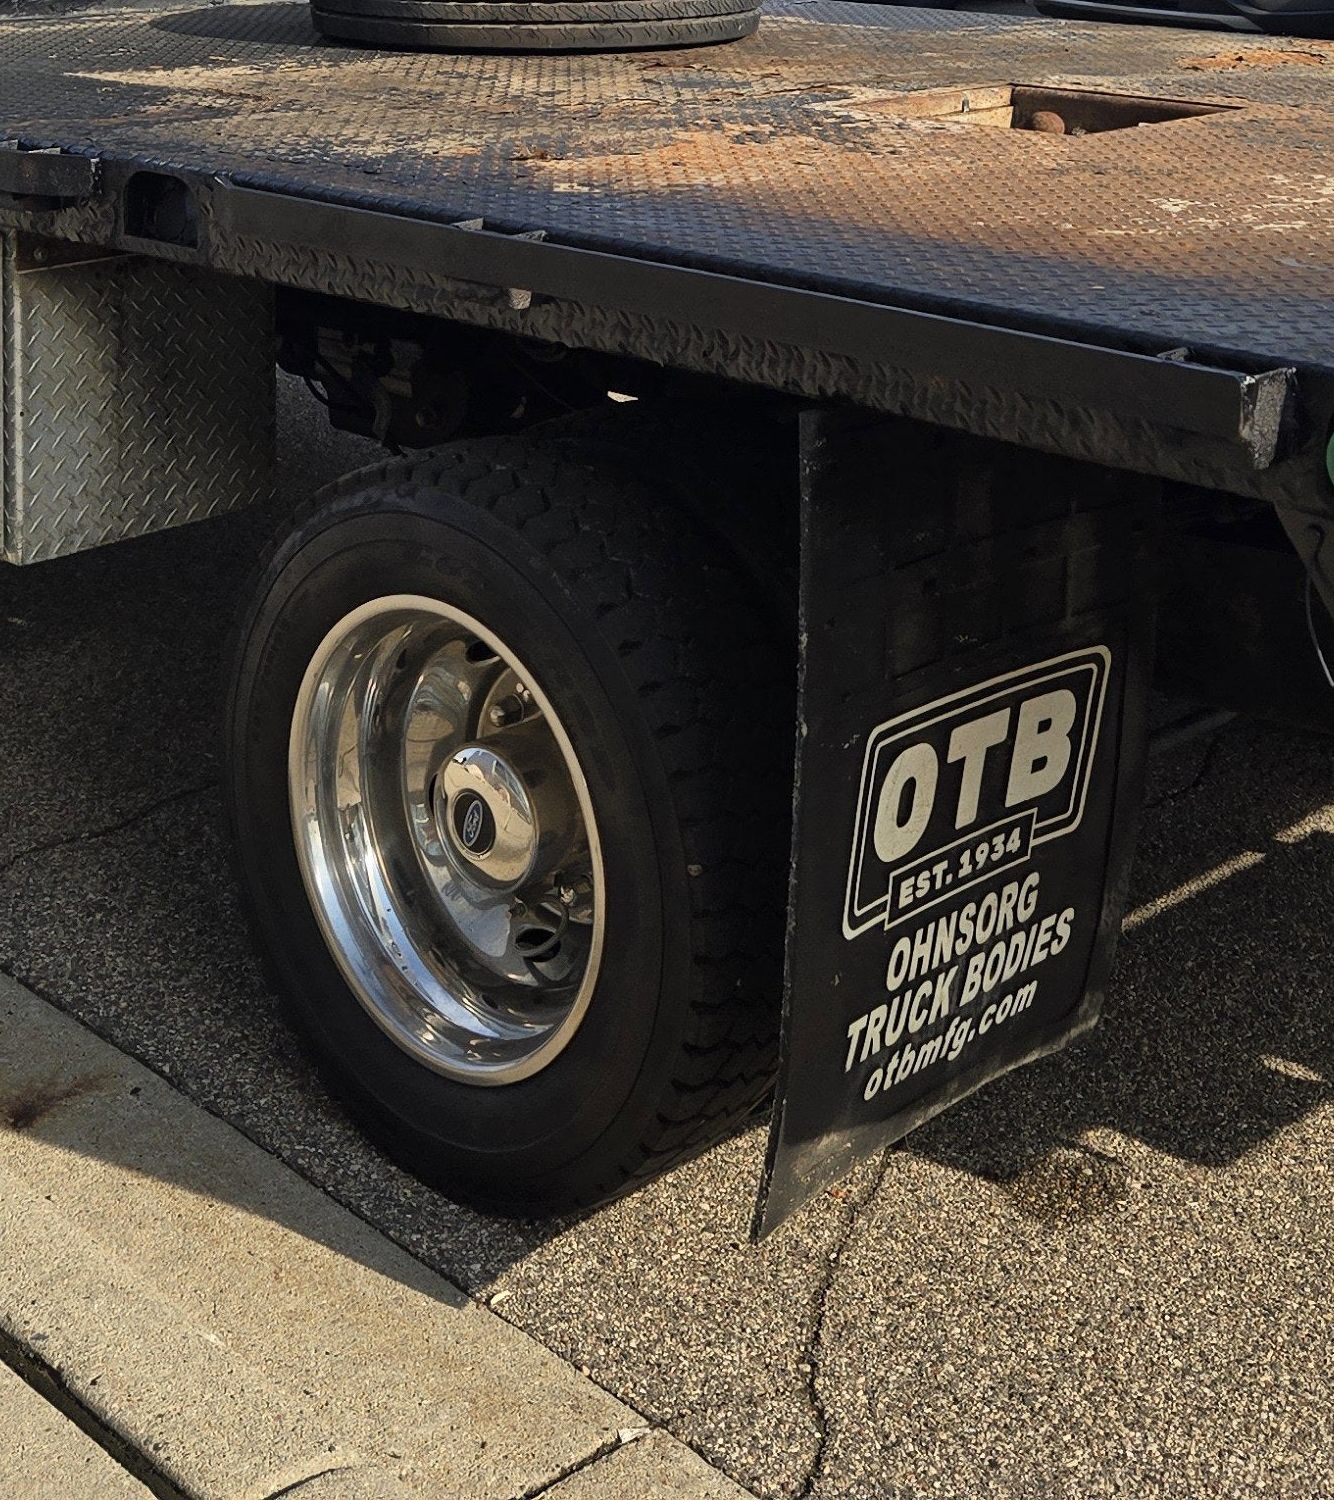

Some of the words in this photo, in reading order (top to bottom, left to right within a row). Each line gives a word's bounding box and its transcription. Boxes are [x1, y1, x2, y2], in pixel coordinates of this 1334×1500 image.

[873, 689, 1077, 863] OTB
[899, 860, 954, 909] EST.
[957, 826, 1022, 878] 1934
[844, 978, 957, 1073] TRUCK
[959, 907, 1075, 1009] BODIES
[886, 872, 1041, 992] OHNSORG
[864, 978, 1038, 1101] otbmfg.com
